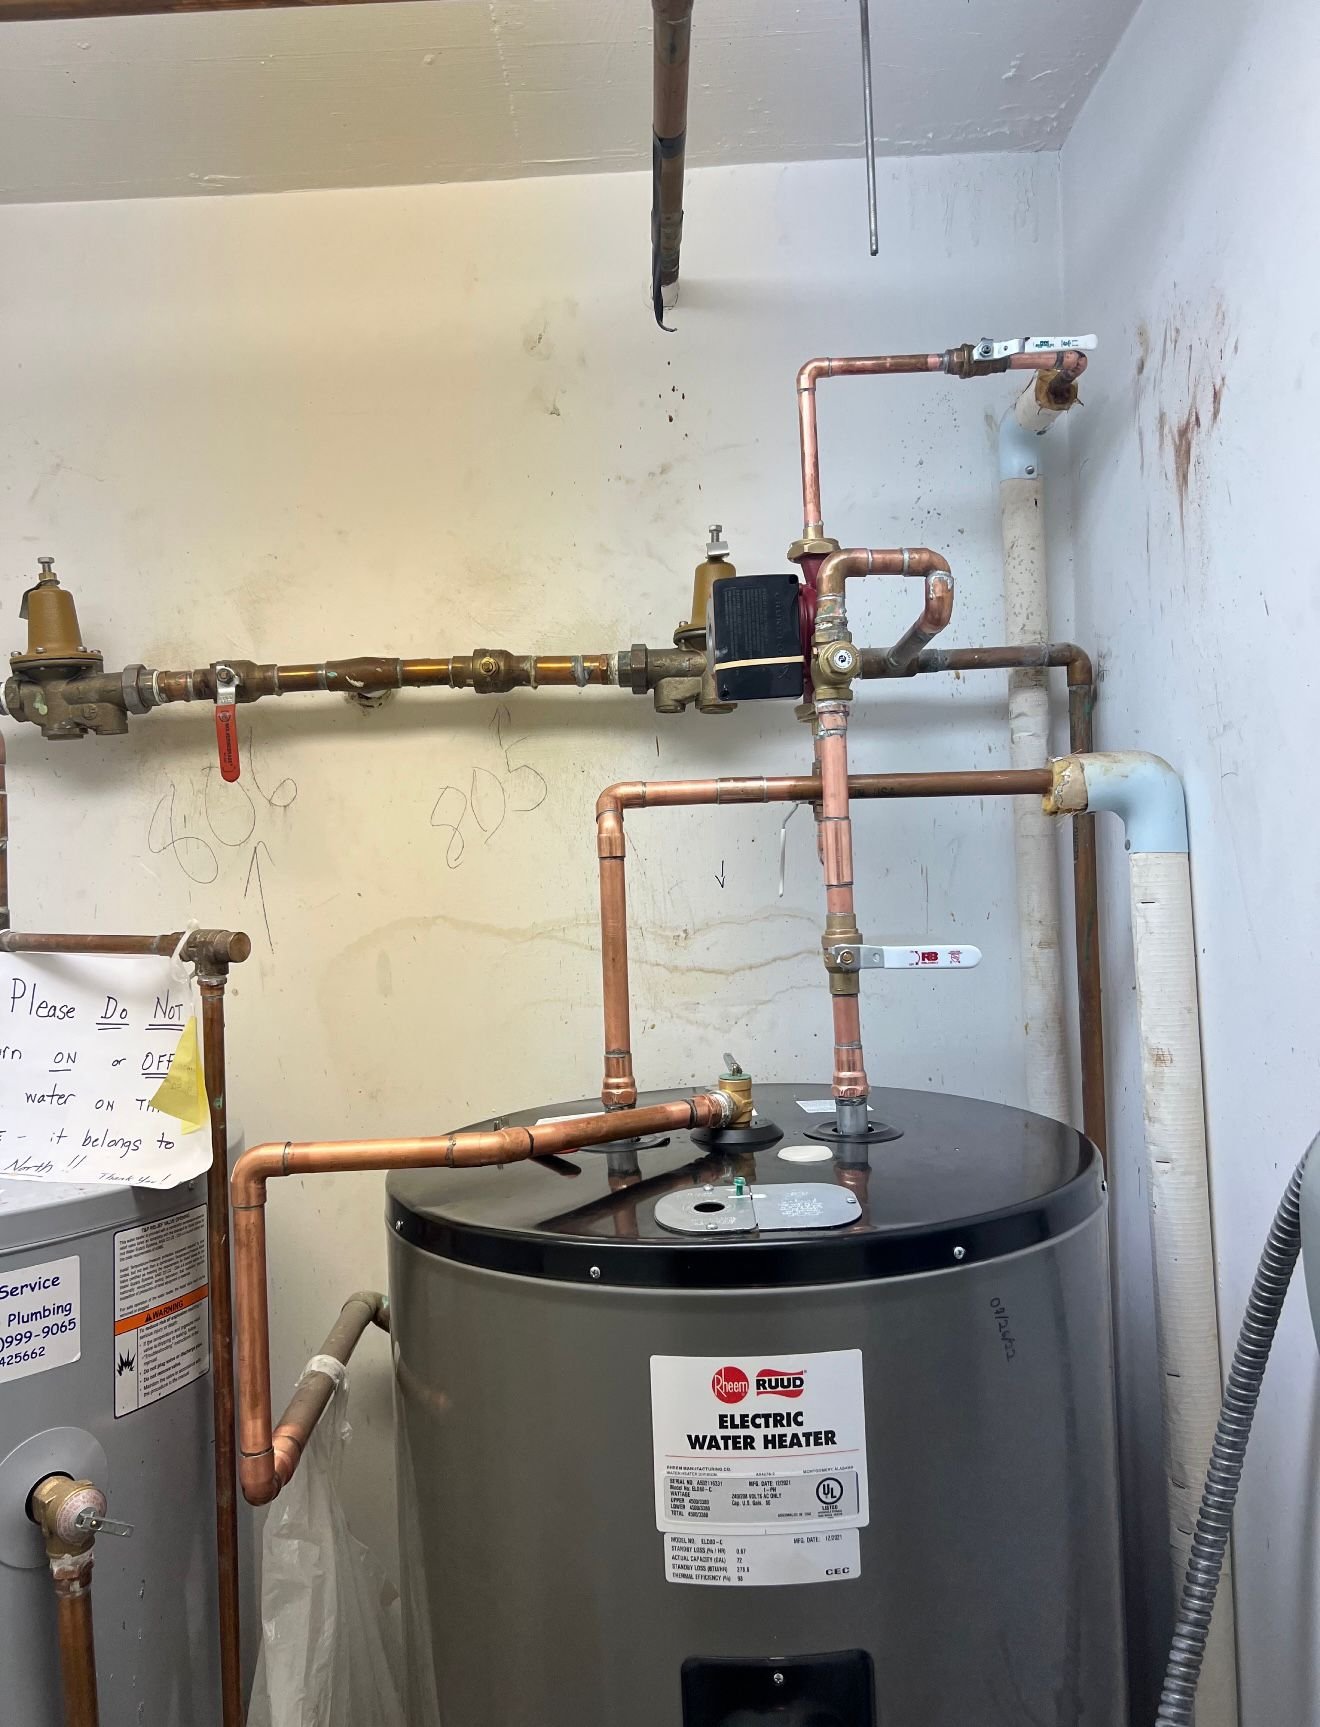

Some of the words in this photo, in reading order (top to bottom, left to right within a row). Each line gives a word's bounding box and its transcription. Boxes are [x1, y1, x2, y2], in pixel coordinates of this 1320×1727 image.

[430, 736, 547, 869] 805
[921, 951, 939, 962] RB
[10, 978, 75, 1020] Please
[53, 1051, 77, 1064] ON
[111, 1056, 127, 1067] or
[25, 1083, 76, 1107] water
[95, 1099, 115, 1111] ON
[50, 1128, 68, 1145] it
[81, 1128, 142, 1159] belongs
[156, 1132, 175, 1150] to
[4, 1155, 54, 1174] North
[0, 1276, 61, 1300] Service
[8, 1302, 72, 1328] Plumbing
[152, 1300, 184, 1320] WARNING
[0, 1346, 46, 1367] 425662
[715, 1368, 748, 1397] Rheem
[756, 1376, 804, 1391] RUUD
[718, 1411, 804, 1430] ELECTRIC
[686, 1434, 756, 1451] WATER
[763, 1430, 837, 1450] HEATER
[825, 1567, 850, 1576] CEC
